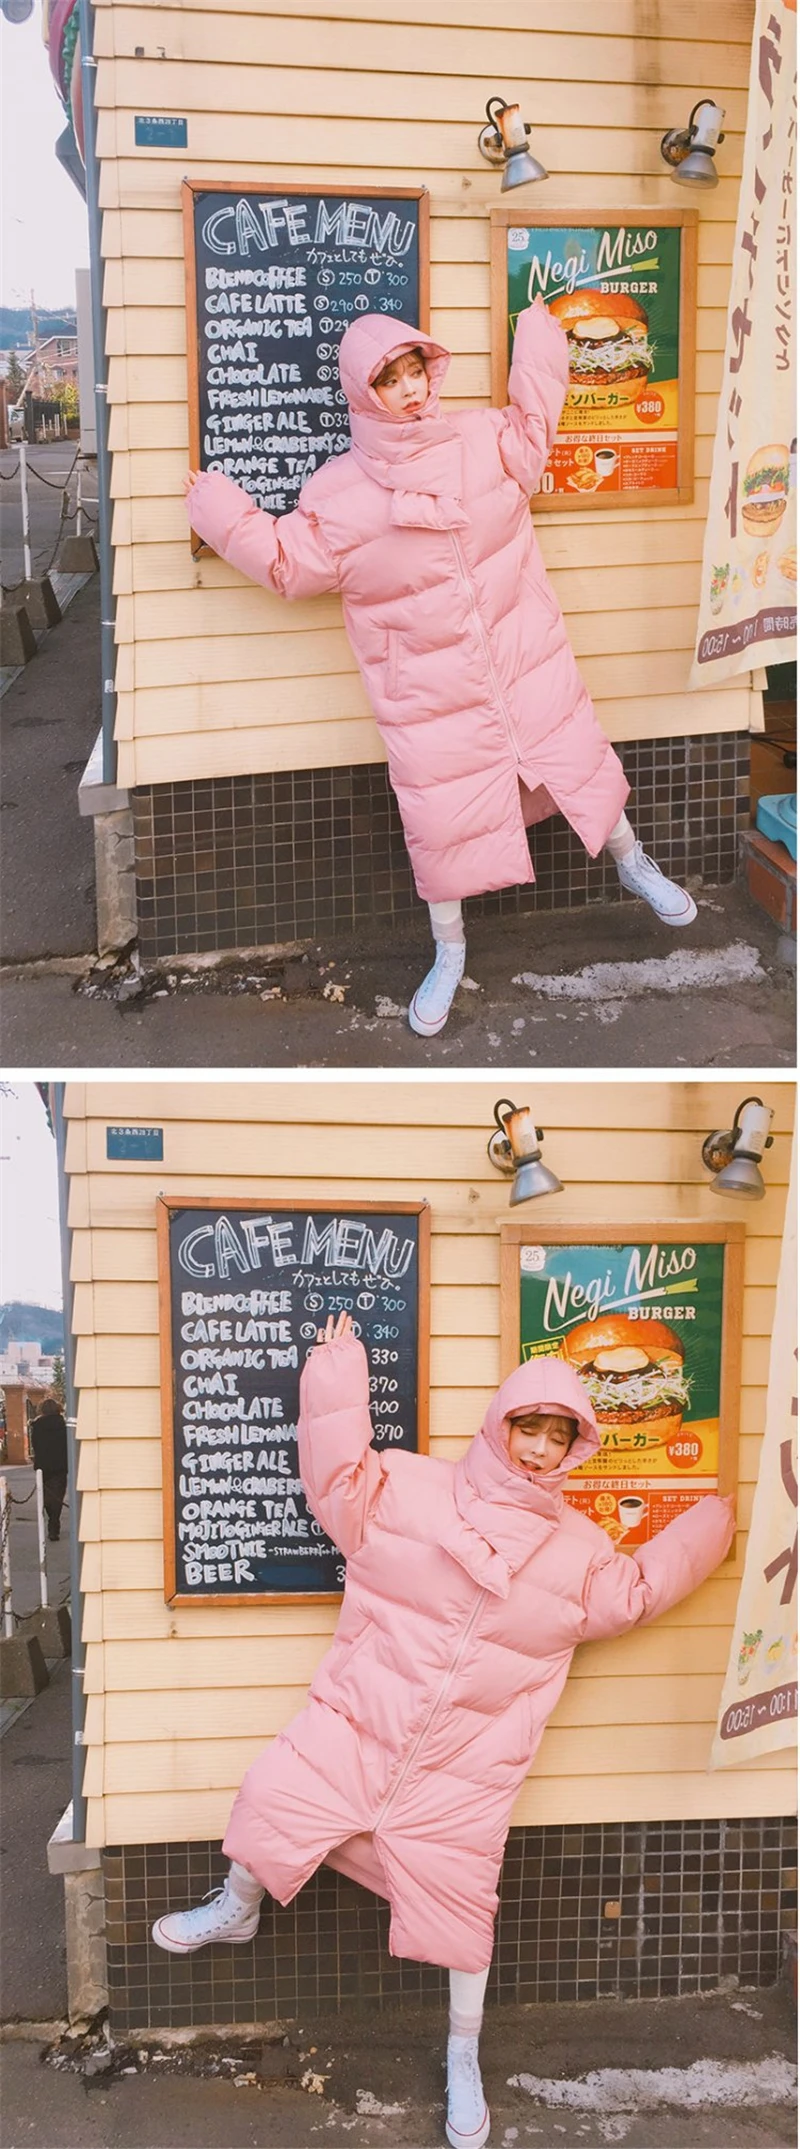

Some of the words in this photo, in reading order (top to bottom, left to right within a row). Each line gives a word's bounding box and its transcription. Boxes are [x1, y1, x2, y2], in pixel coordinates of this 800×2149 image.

[202, 198, 312, 256] CAFE
[313, 199, 416, 256] MENU
[528, 249, 590, 303] Negi
[596, 227, 658, 273] Miso
[339, 272, 362, 285] 250
[386, 272, 409, 286] 300
[600, 281, 658, 294] BURGER
[205, 293, 253, 314] CAFE
[255, 293, 307, 314] LATTE
[331, 300, 354, 314] 290
[379, 298, 403, 311] 340
[204, 320, 283, 341] ORGANIC
[284, 316, 312, 337] TEA
[207, 341, 258, 363] CHAI
[206, 363, 302, 386] CHOCOLATE
[207, 388, 259, 409] FRESH
[260, 387, 334, 407] LEMONADE
[637, 401, 662, 414] ¥380
[206, 412, 275, 434] GINGER
[277, 411, 312, 434] ALE
[335, 412, 350, 427] 32
[206, 456, 279, 476] ORANGE
[285, 454, 316, 475] TEA
[178, 1215, 298, 1279] CAFE
[300, 1216, 415, 1278] MENU
[525, 1250, 540, 1262] 25
[544, 1270, 616, 1332] Negi
[624, 1244, 697, 1296] Miso
[328, 1297, 353, 1311] 250
[382, 1298, 406, 1312] 300
[628, 1306, 696, 1320] BURGER
[181, 1317, 233, 1341] CAFE
[235, 1317, 292, 1341] LATTE
[373, 1324, 399, 1340] 340
[180, 1348, 266, 1371] ORGANIC
[267, 1345, 298, 1368] TEA
[371, 1348, 399, 1365] 330
[183, 1372, 239, 1397] CHAI
[368, 1375, 398, 1393] 370
[182, 1397, 285, 1421] CHOCOLATE
[369, 1402, 399, 1417] 400
[183, 1425, 240, 1447] FRESH
[373, 1424, 404, 1442] 370
[602, 1433, 660, 1447] バーガー
[669, 1442, 699, 1457] ¥380
[181, 1451, 254, 1475] GINGER
[256, 1450, 292, 1475] ALE
[583, 1479, 651, 1489] お得な終日セット
[182, 1498, 257, 1521] ORANGE
[262, 1497, 298, 1520] TEA
[182, 1540, 267, 1562] SMOOTHIE
[185, 1558, 256, 1585] BEER
